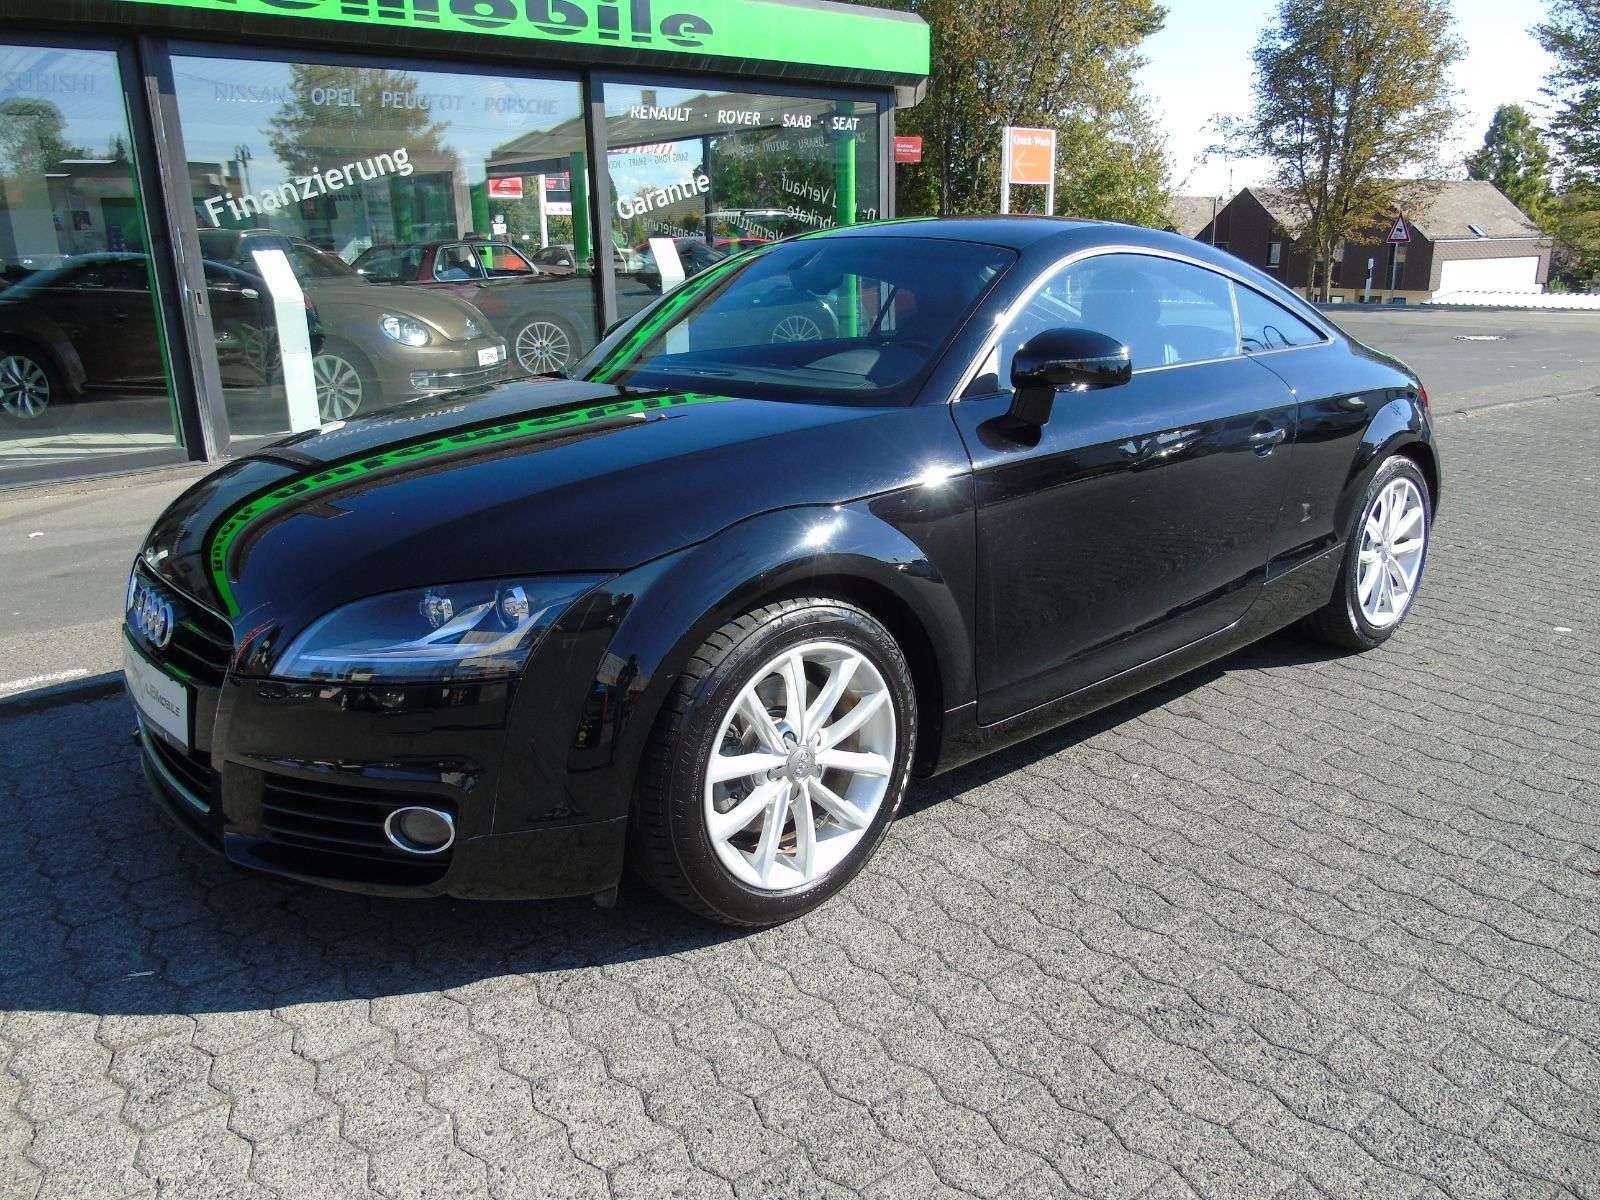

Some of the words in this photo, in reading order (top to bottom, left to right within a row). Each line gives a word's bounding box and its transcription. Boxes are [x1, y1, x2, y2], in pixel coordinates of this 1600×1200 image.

[311, 87, 361, 107] OPEL
[484, 95, 560, 115] PORSCHE
[630, 105, 693, 122] RENAULT
[717, 110, 762, 126] ROVER
[782, 113, 812, 129] SAAB
[832, 116, 860, 131] SEAT
[204, 147, 414, 228] Finanzierung
[616, 174, 710, 220] Garantie
